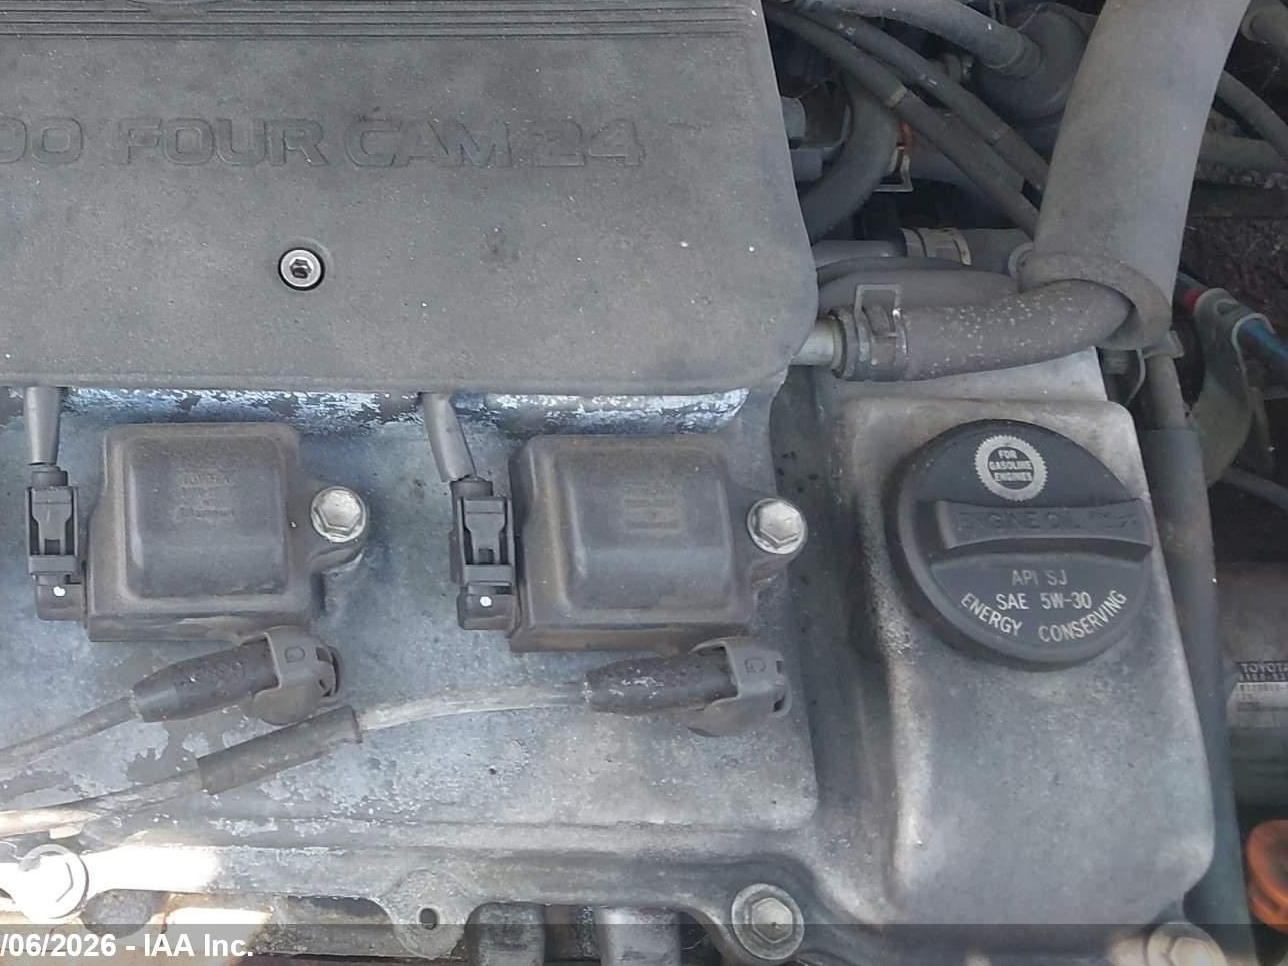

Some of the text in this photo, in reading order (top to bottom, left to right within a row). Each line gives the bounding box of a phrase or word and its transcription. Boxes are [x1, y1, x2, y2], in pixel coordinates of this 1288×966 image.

[117, 117, 330, 168] FOUR
[998, 449, 1018, 459] FOR
[988, 460, 1033, 471] GASOLINE
[993, 472, 1033, 483] ENGINES
[1012, 569, 1069, 586] API SJ
[995, 591, 1093, 610] SAE 5W-30
[960, 588, 1128, 643] ENERGY CONSERVING
